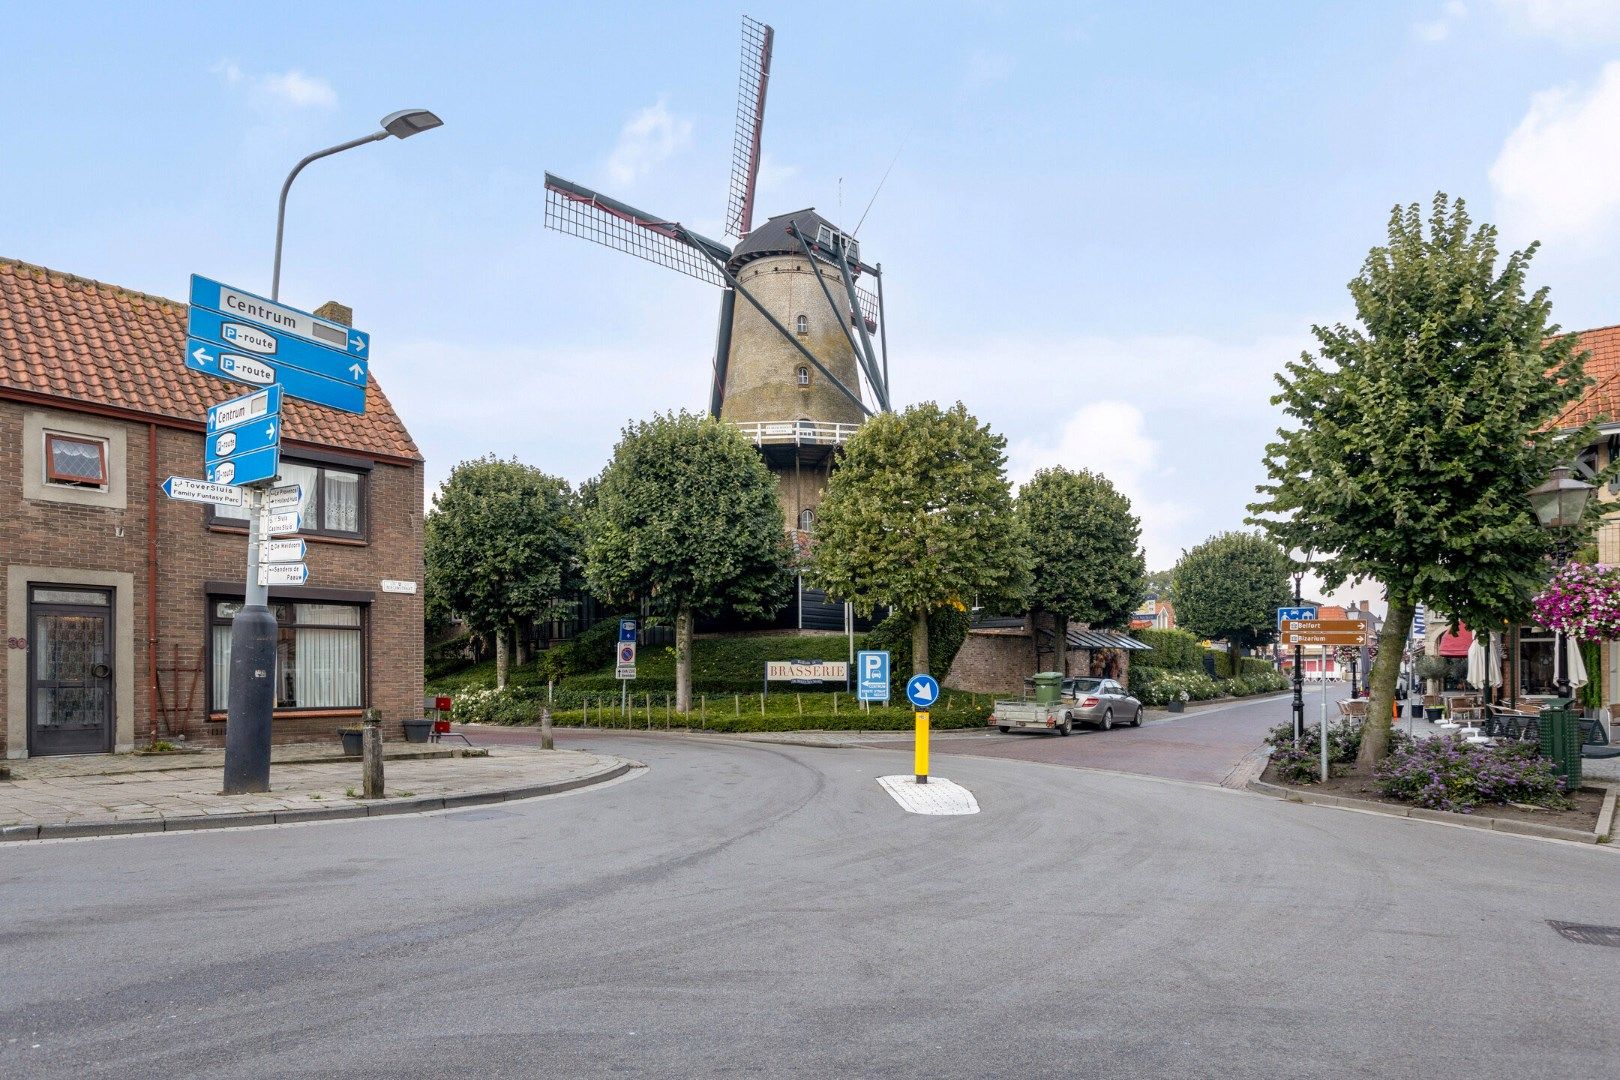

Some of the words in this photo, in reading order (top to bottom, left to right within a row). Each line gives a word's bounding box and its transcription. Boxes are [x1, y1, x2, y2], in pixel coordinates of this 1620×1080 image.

[226, 295, 296, 329] Centrum
[218, 406, 245, 424] Centrum
[173, 489, 196, 498] Family
[8, 637, 26, 649] 30
[769, 665, 844, 677] BRASSERIE
[865, 655, 882, 679] P
